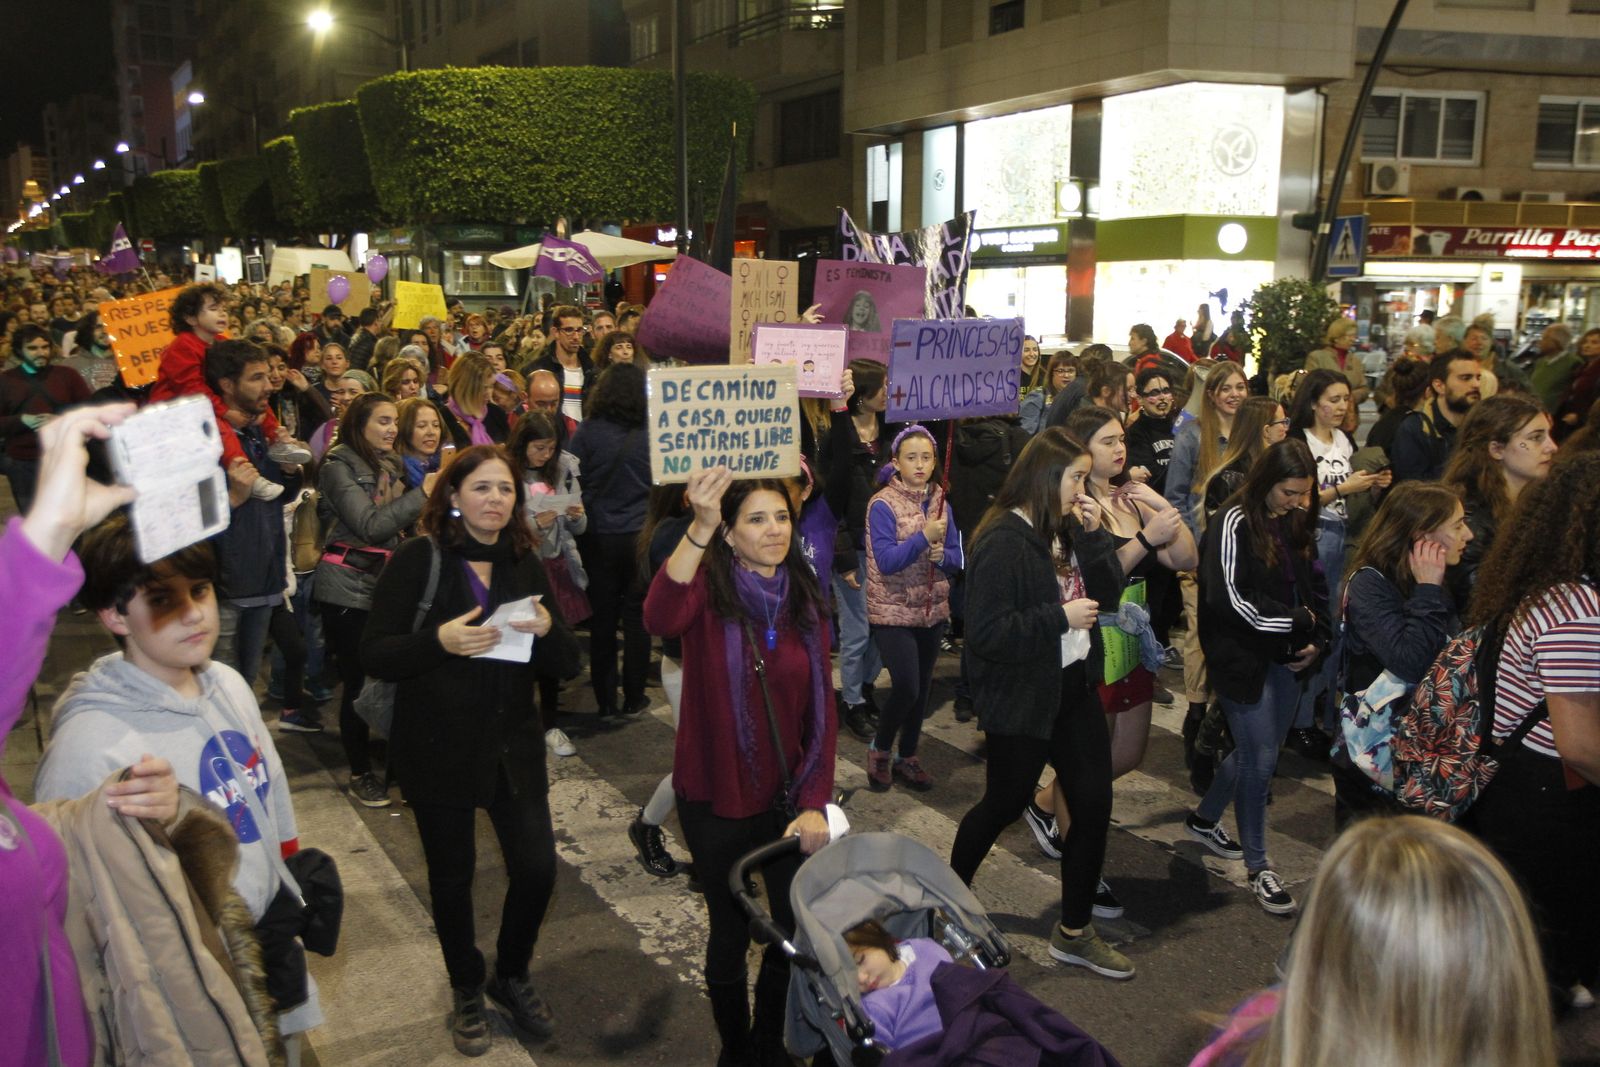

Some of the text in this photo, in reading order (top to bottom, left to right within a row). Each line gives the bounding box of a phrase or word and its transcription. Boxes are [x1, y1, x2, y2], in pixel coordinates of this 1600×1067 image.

[1368, 227, 1391, 235] ATE
[1461, 228, 1554, 245] Parrilla
[826, 267, 892, 283] ES FEMINISTA
[109, 299, 175, 321] RESPE
[118, 318, 172, 339] NUES
[916, 322, 1021, 360] PRINCESAS
[662, 373, 777, 403] DE CAMINO
[904, 368, 1018, 411] ALCALDESAS
[658, 406, 792, 428] A CASA, QUIERO
[658, 427, 793, 453] SENTIRME LIBRE
[662, 450, 780, 475] NO VALIENTE
